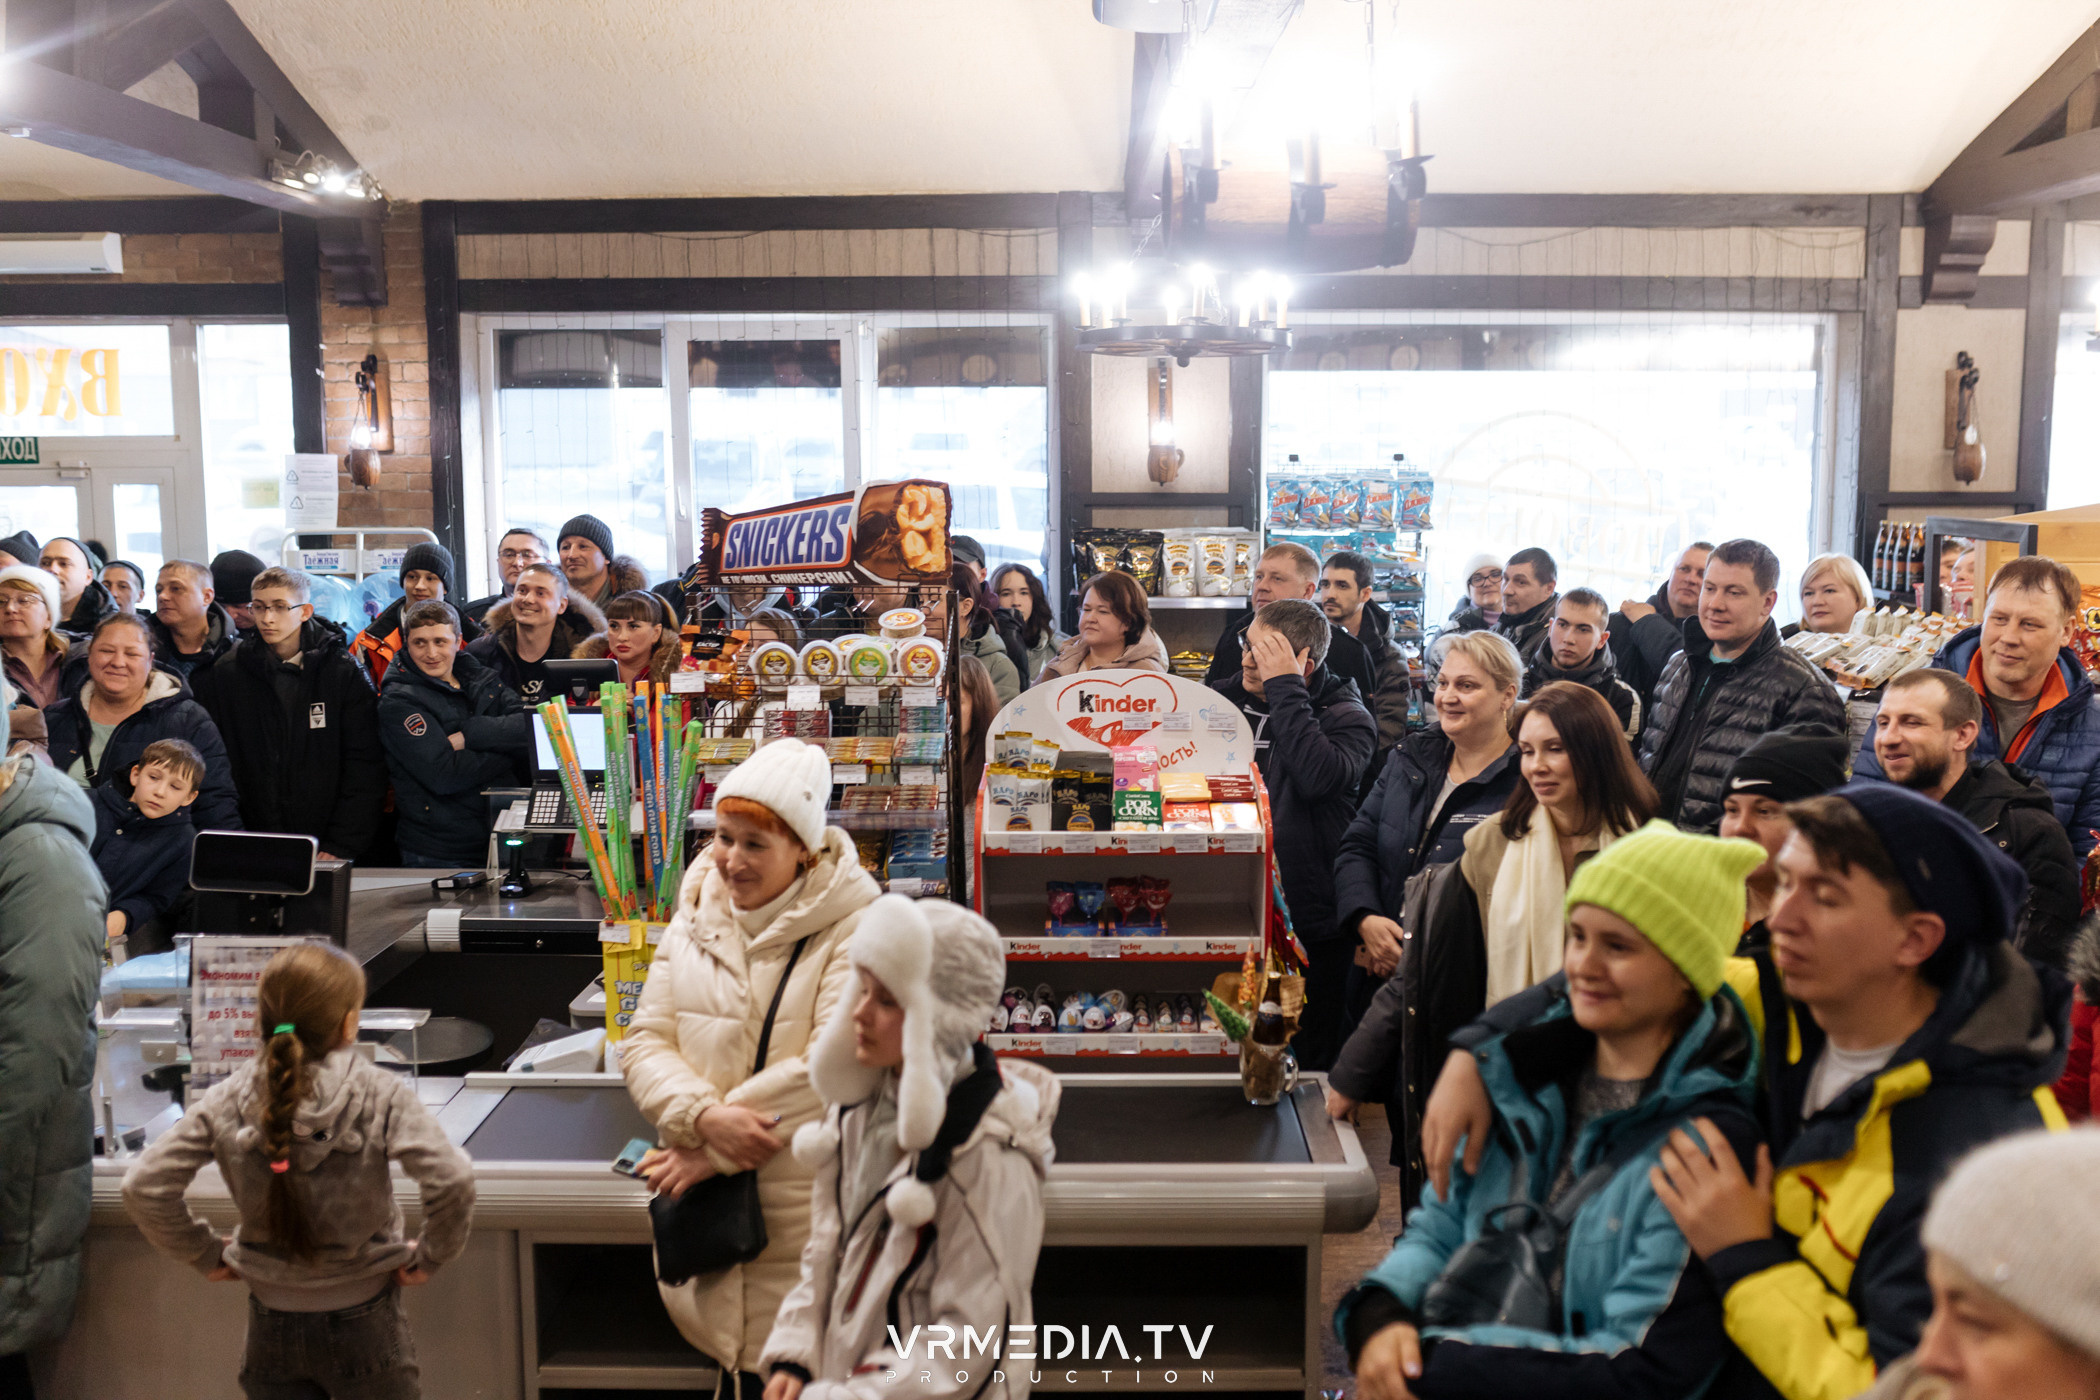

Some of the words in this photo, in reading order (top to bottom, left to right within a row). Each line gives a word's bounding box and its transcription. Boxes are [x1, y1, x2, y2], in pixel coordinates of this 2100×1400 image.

[0, 437, 38, 461] ХОД
[724, 505, 853, 570] SNICKERS
[770, 571, 859, 584] СНИКЕРСНИ!
[1125, 799, 1152, 809] POP
[1118, 807, 1158, 817] CORN
[648, 808, 658, 834] GUM
[1111, 836, 1128, 846] kin
[1207, 836, 1225, 845] kin
[650, 834, 661, 865] CORD
[1120, 942, 1142, 951] nder
[200, 970, 252, 981] Экономим
[614, 980, 643, 996] ME
[207, 1010, 221, 1021] до
[224, 1008, 239, 1019] 5%
[241, 1011, 258, 1019] вы
[220, 1048, 255, 1061] упаков
